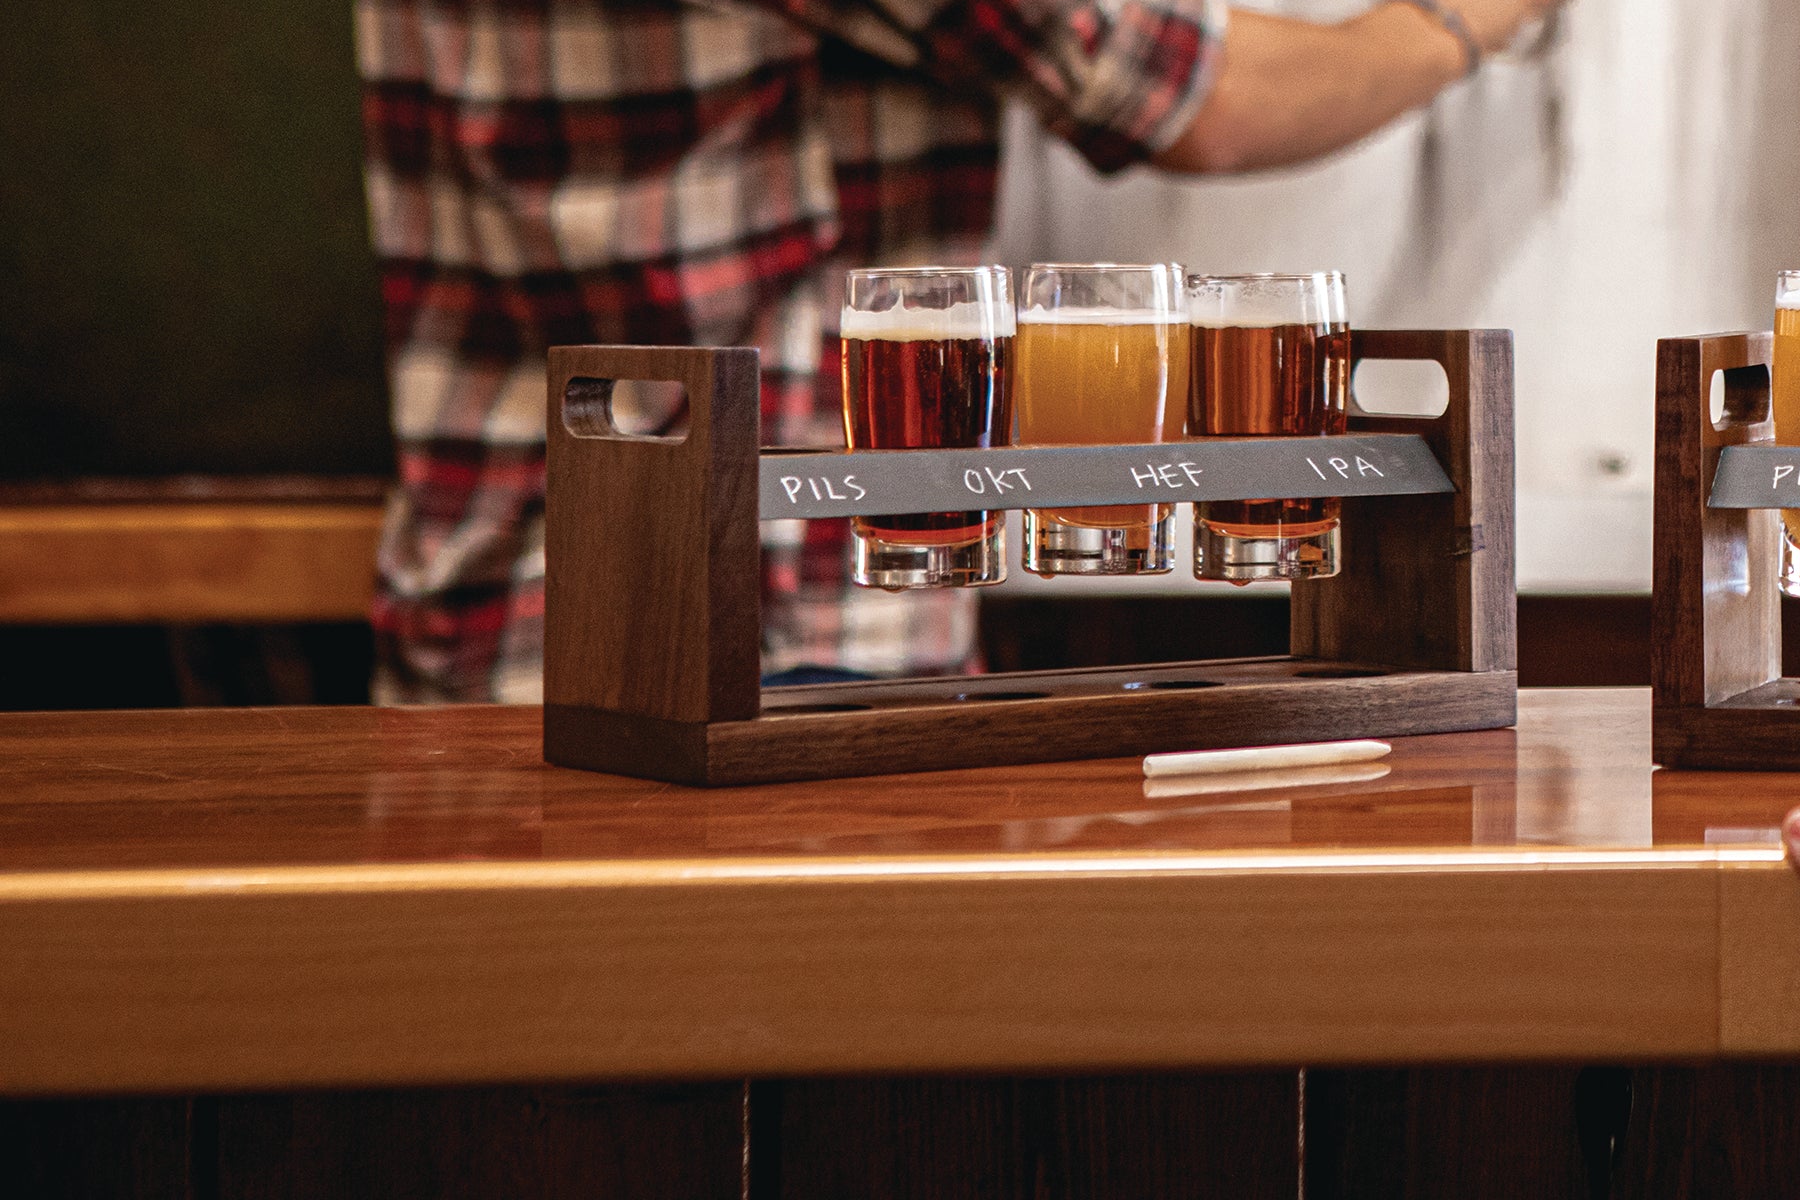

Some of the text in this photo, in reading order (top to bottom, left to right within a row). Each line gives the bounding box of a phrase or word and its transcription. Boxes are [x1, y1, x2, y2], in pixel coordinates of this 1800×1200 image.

[780, 456, 1385, 504] PILS OKT HEF IPA
